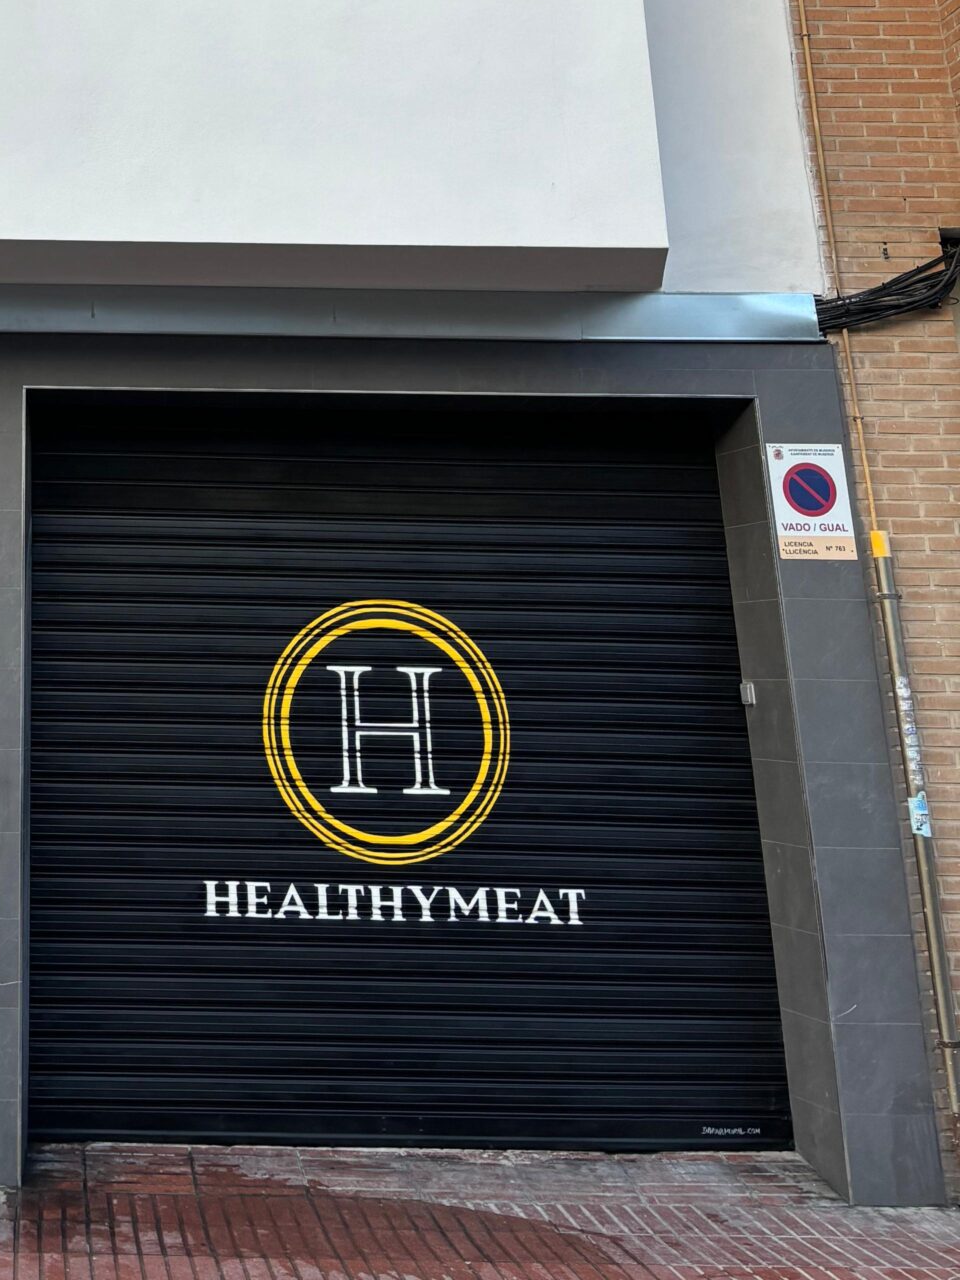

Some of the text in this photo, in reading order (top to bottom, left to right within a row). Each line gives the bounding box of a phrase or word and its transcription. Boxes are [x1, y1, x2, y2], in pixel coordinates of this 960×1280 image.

[781, 522, 811, 532] VADO
[819, 523, 849, 532] GUAL
[326, 665, 451, 796] H
[203, 880, 586, 926] HEALTHYMEAT
